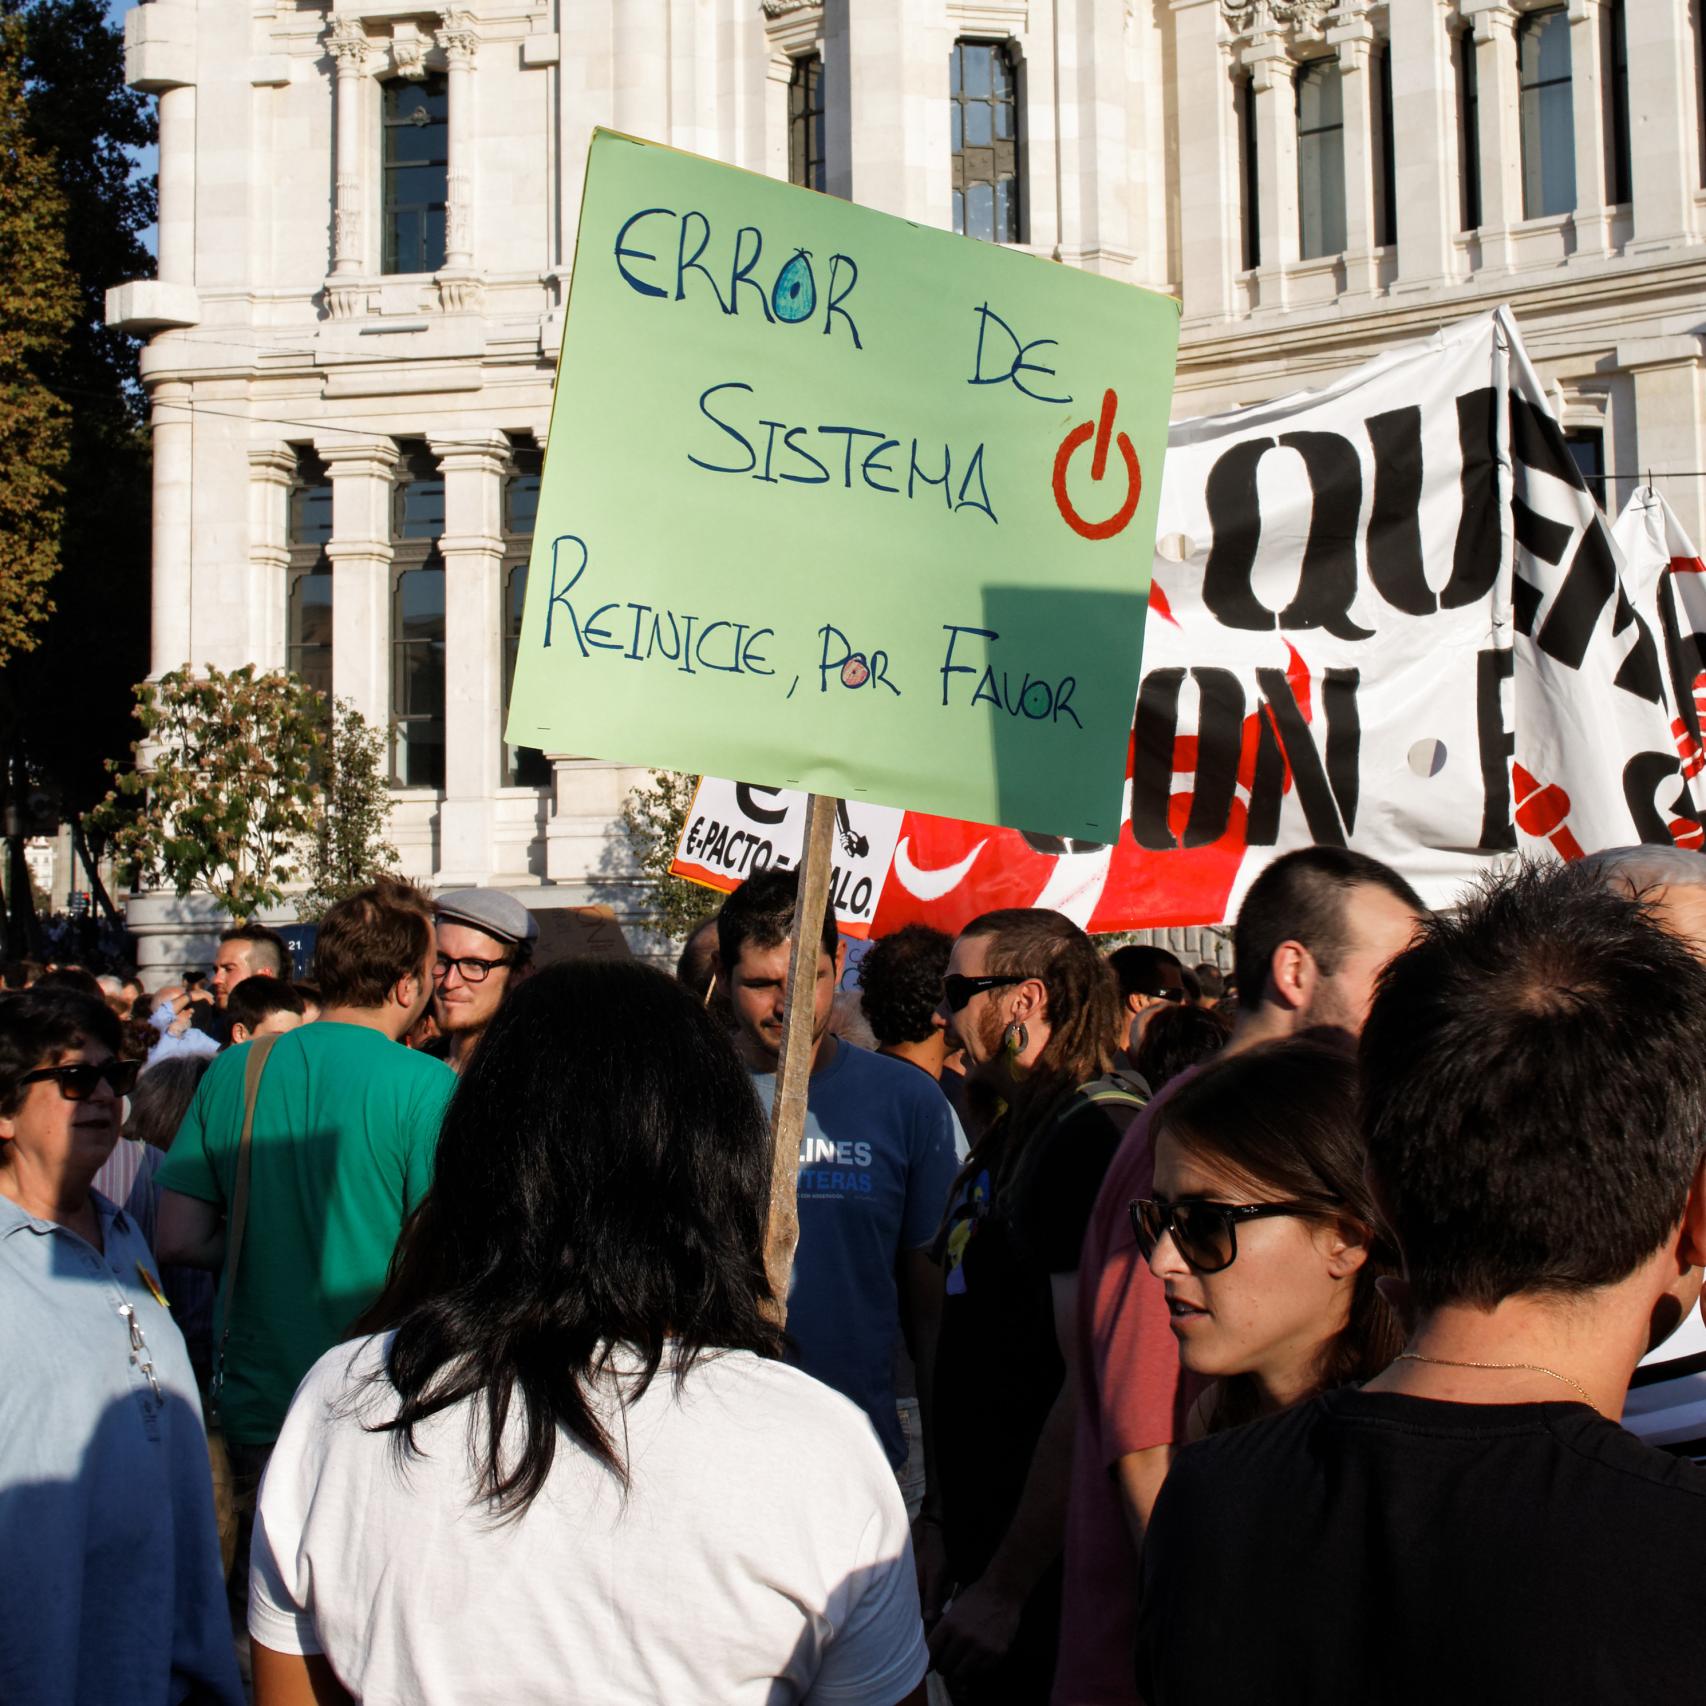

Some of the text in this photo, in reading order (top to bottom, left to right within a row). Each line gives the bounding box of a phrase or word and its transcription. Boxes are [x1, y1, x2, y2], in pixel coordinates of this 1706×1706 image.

[614, 208, 1073, 403] ERROR DE
[688, 383, 998, 523] SISTEMA
[543, 535, 1082, 729] REINICIE, POR FAVOR
